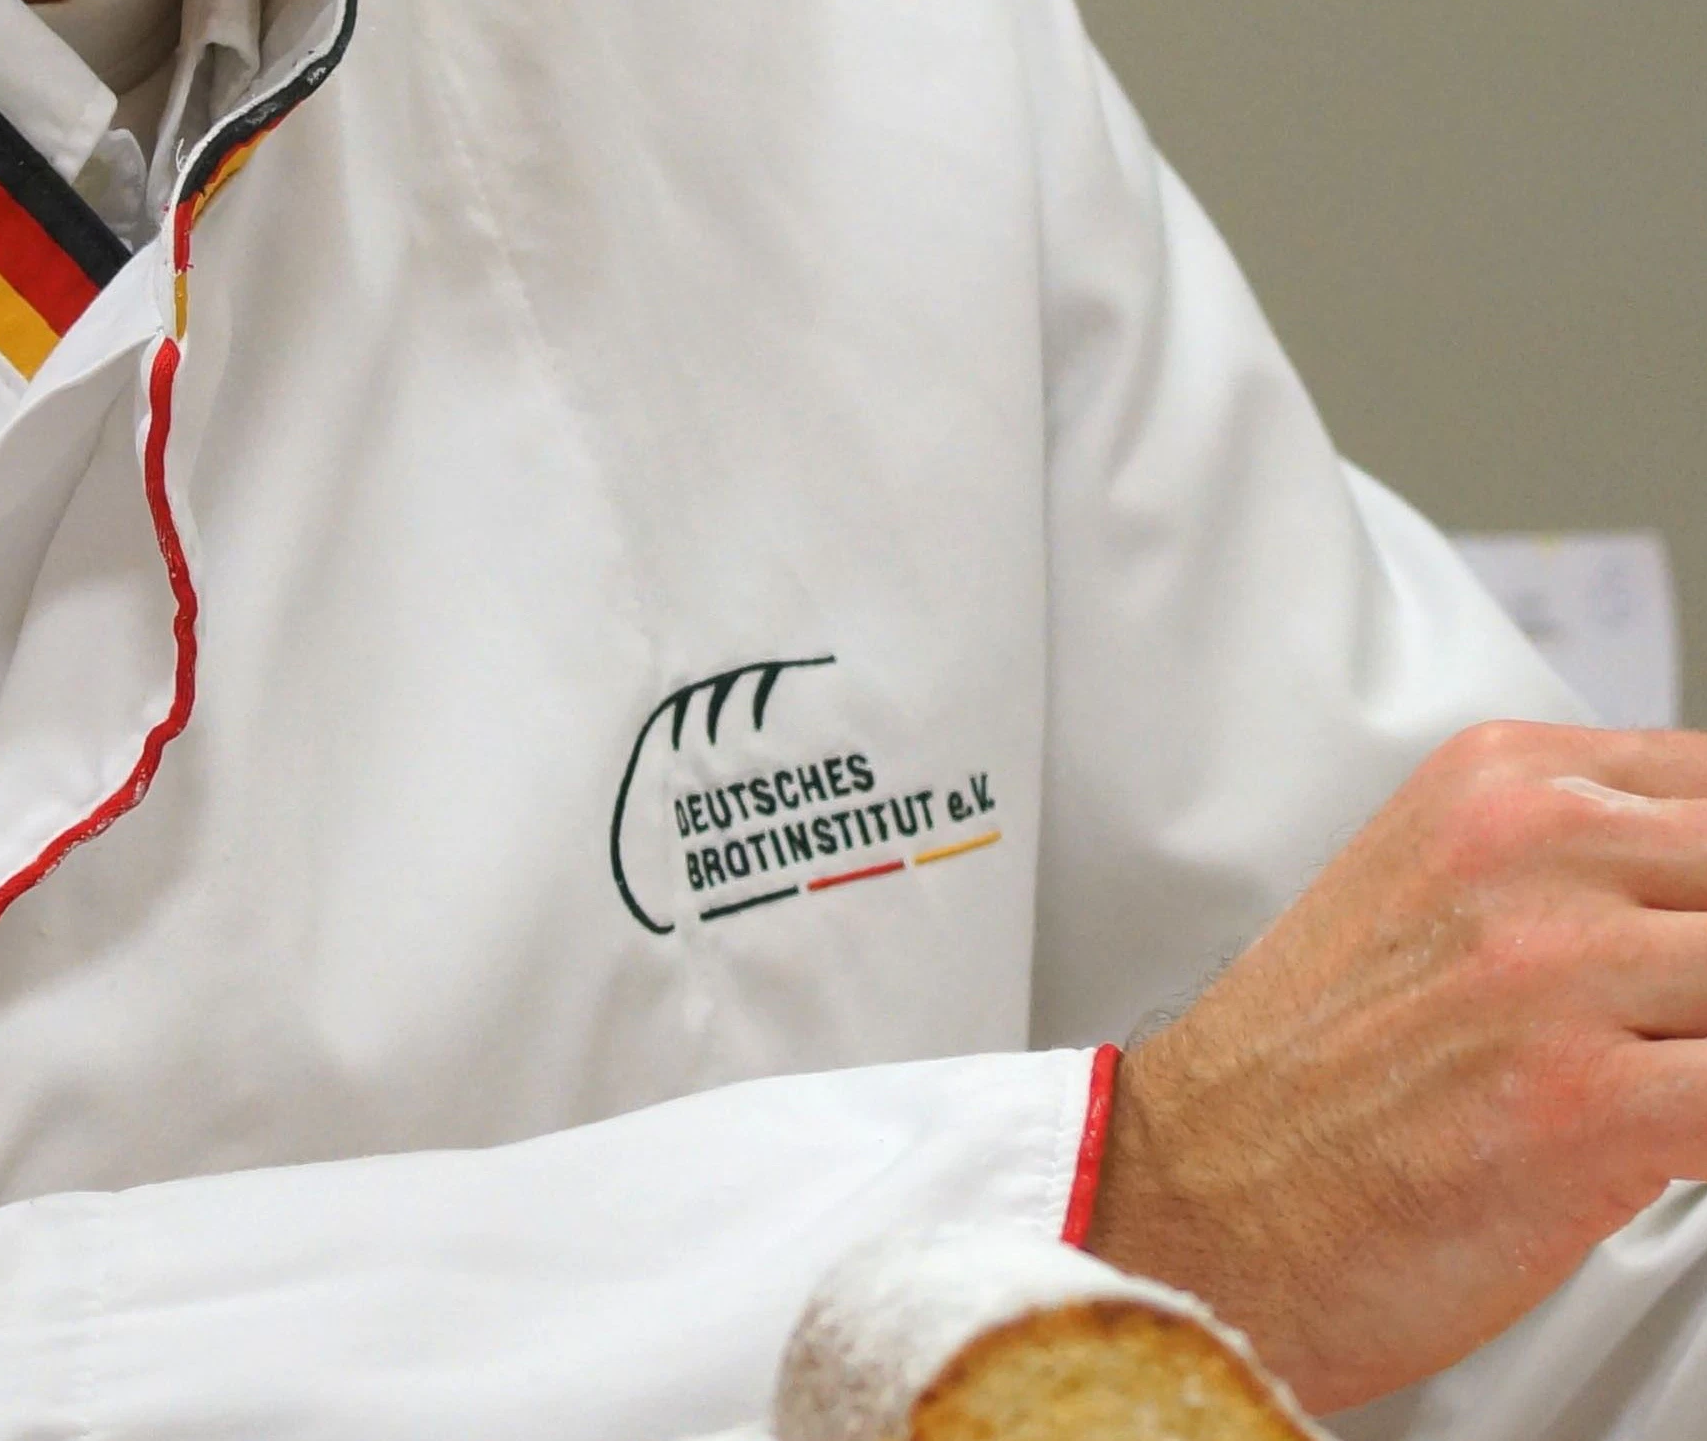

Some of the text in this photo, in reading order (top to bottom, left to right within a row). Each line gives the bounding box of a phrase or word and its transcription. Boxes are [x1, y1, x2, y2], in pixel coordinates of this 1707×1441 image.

[674, 753, 875, 838] DEUTSCHES
[686, 771, 996, 891] BROTINSTITUT e.V.
